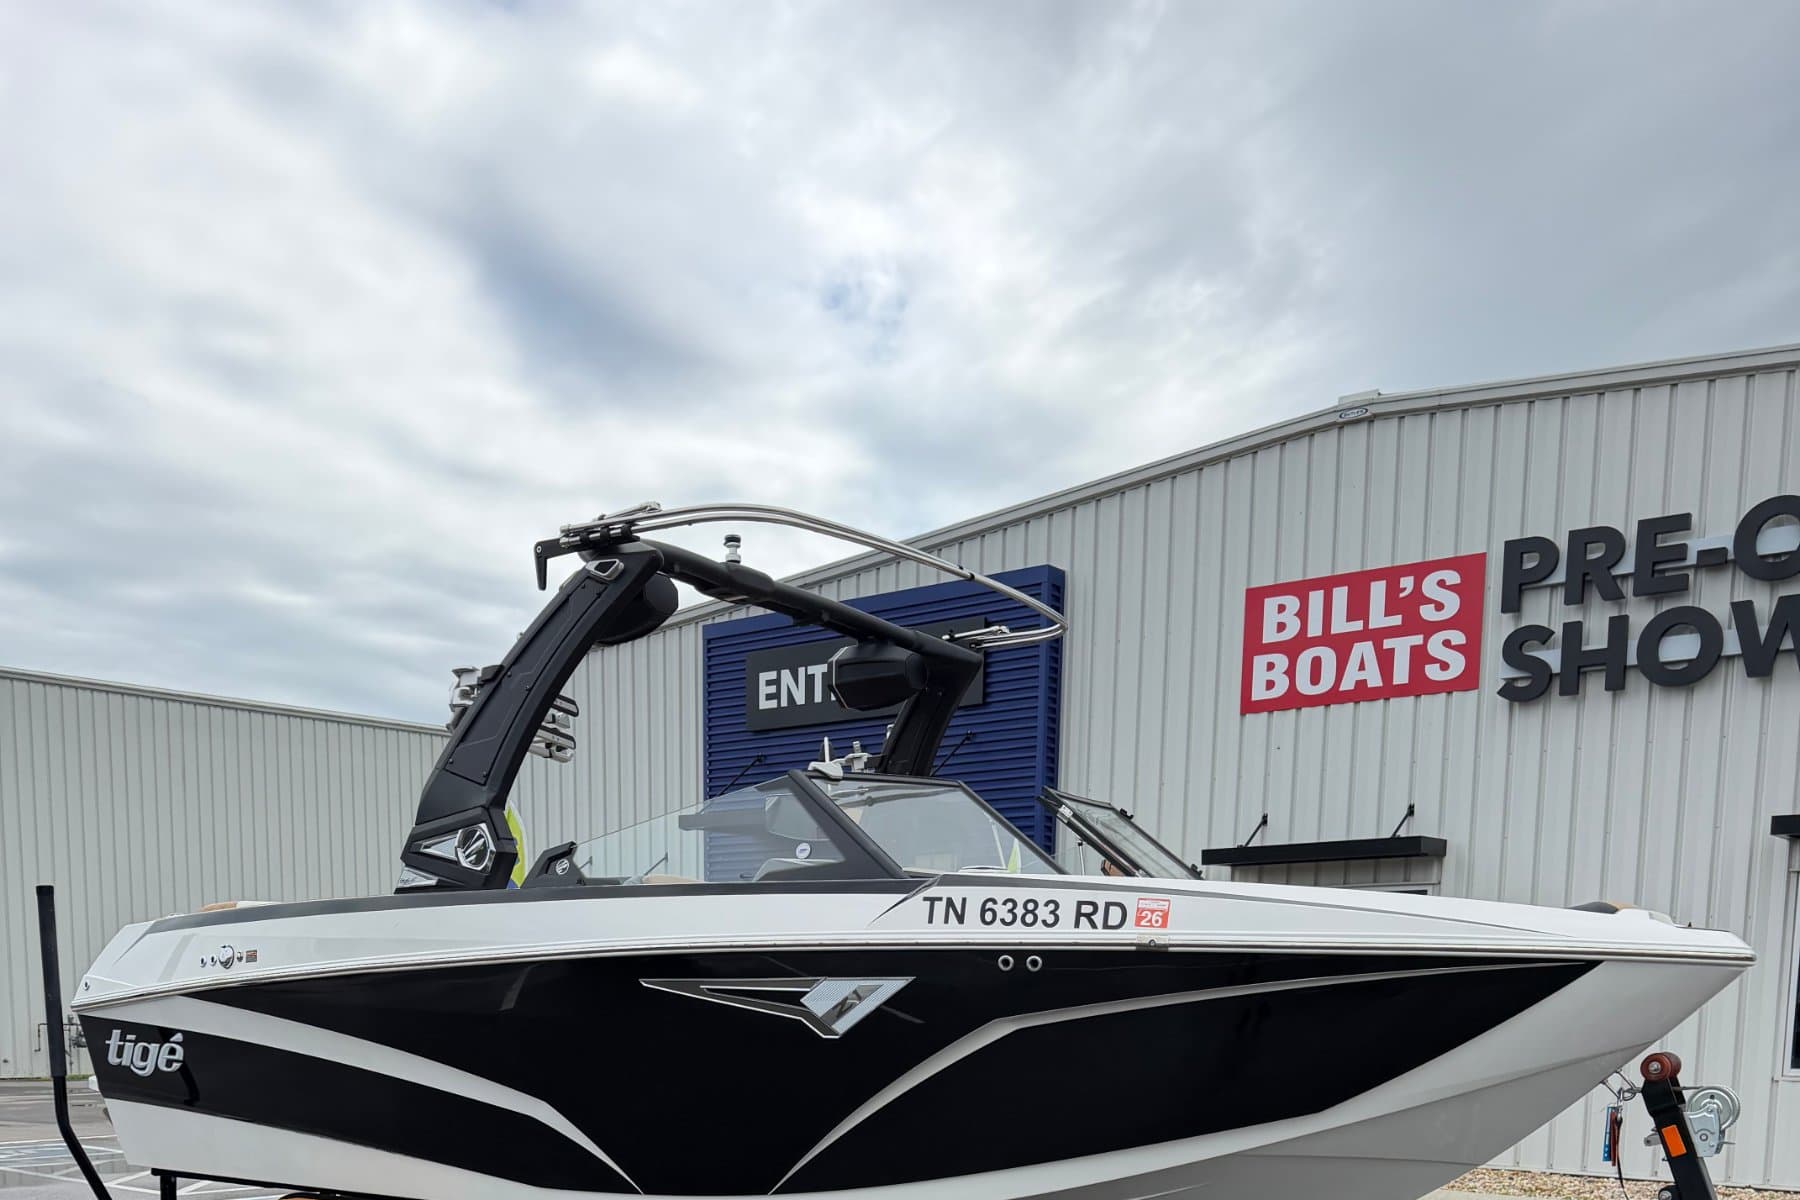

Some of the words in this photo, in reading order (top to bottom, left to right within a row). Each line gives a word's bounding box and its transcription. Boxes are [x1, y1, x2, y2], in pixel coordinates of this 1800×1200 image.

[1262, 569, 1462, 644] BILL'S
[758, 663, 837, 711] ENT
[1250, 629, 1467, 702] BOATS
[922, 896, 968, 925] TN
[979, 897, 1061, 928] 6383
[1073, 900, 1128, 930] RD
[1140, 910, 1162, 927] 26
[105, 1029, 184, 1077] tigé
